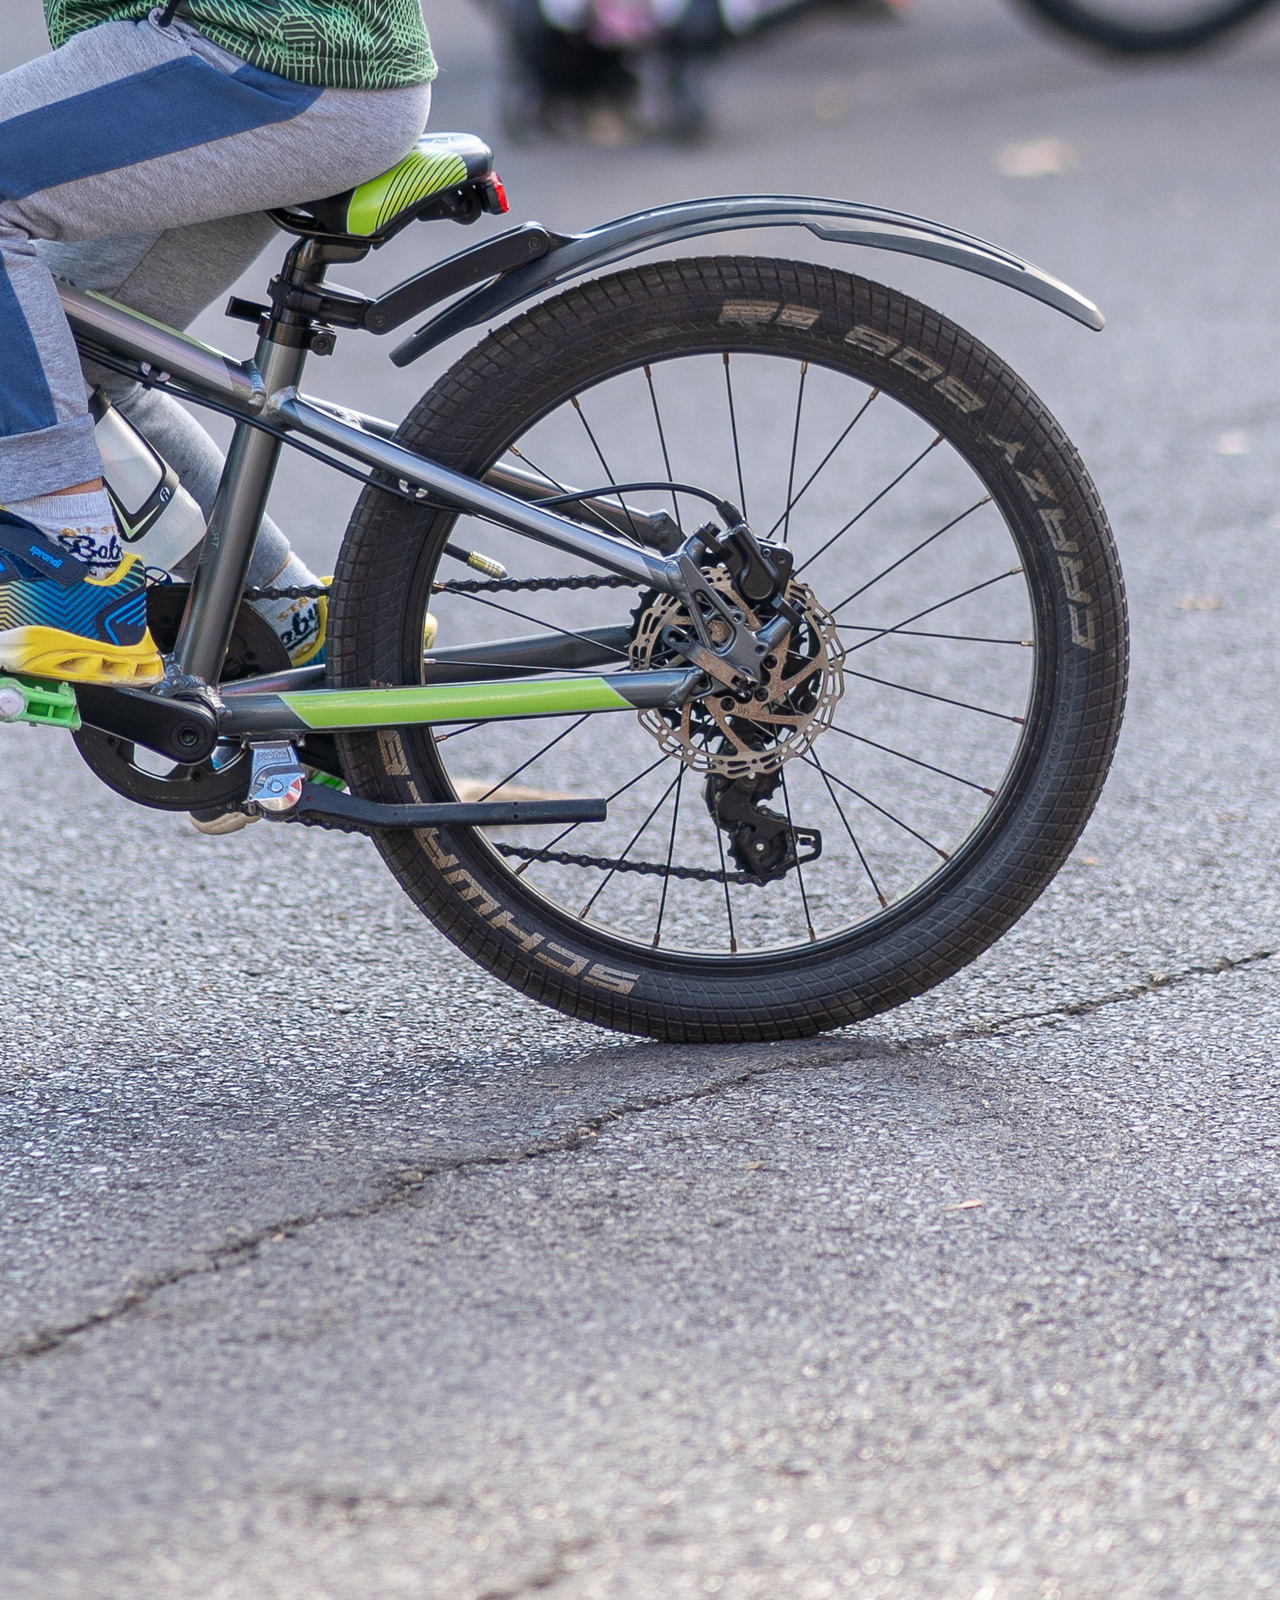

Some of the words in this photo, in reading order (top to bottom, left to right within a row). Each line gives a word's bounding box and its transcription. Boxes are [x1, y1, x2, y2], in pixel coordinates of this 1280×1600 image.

[845, 326, 986, 416] BOB
[29, 544, 64, 569] sprandi
[58, 534, 123, 561] Bab
[987, 433, 1096, 651] CRAZY
[280, 603, 320, 645] aby
